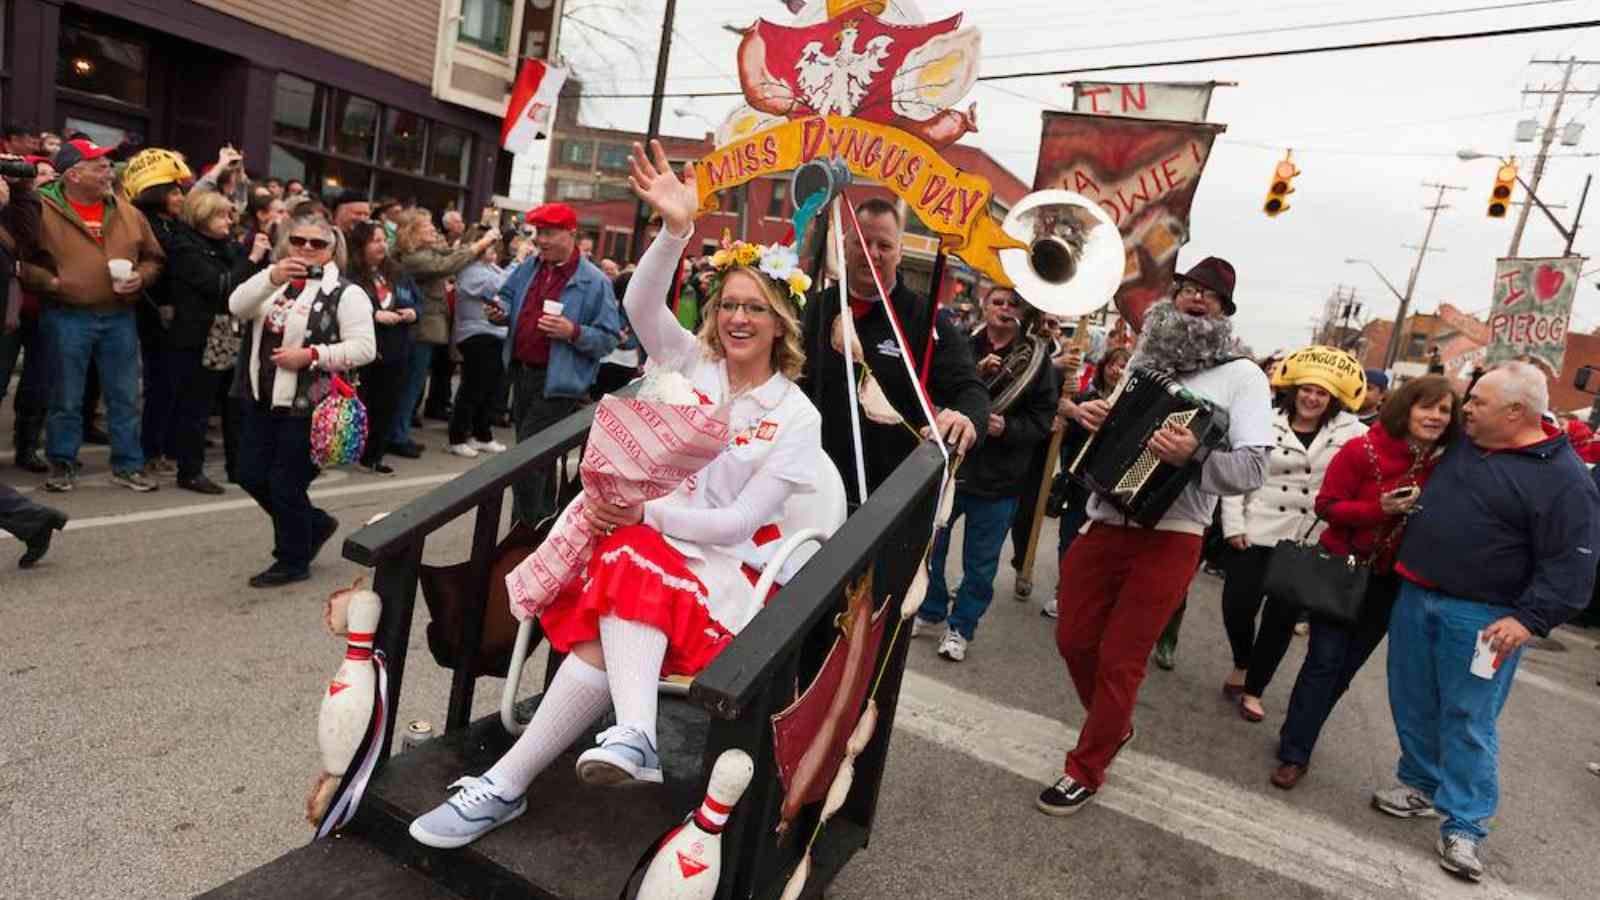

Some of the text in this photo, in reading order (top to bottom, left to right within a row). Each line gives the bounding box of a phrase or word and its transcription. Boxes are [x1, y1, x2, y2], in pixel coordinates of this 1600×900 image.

[705, 116, 984, 227] MISS DYNGUS DAY
[1499, 269, 1526, 305] I
[1337, 359, 1358, 376] DAY
